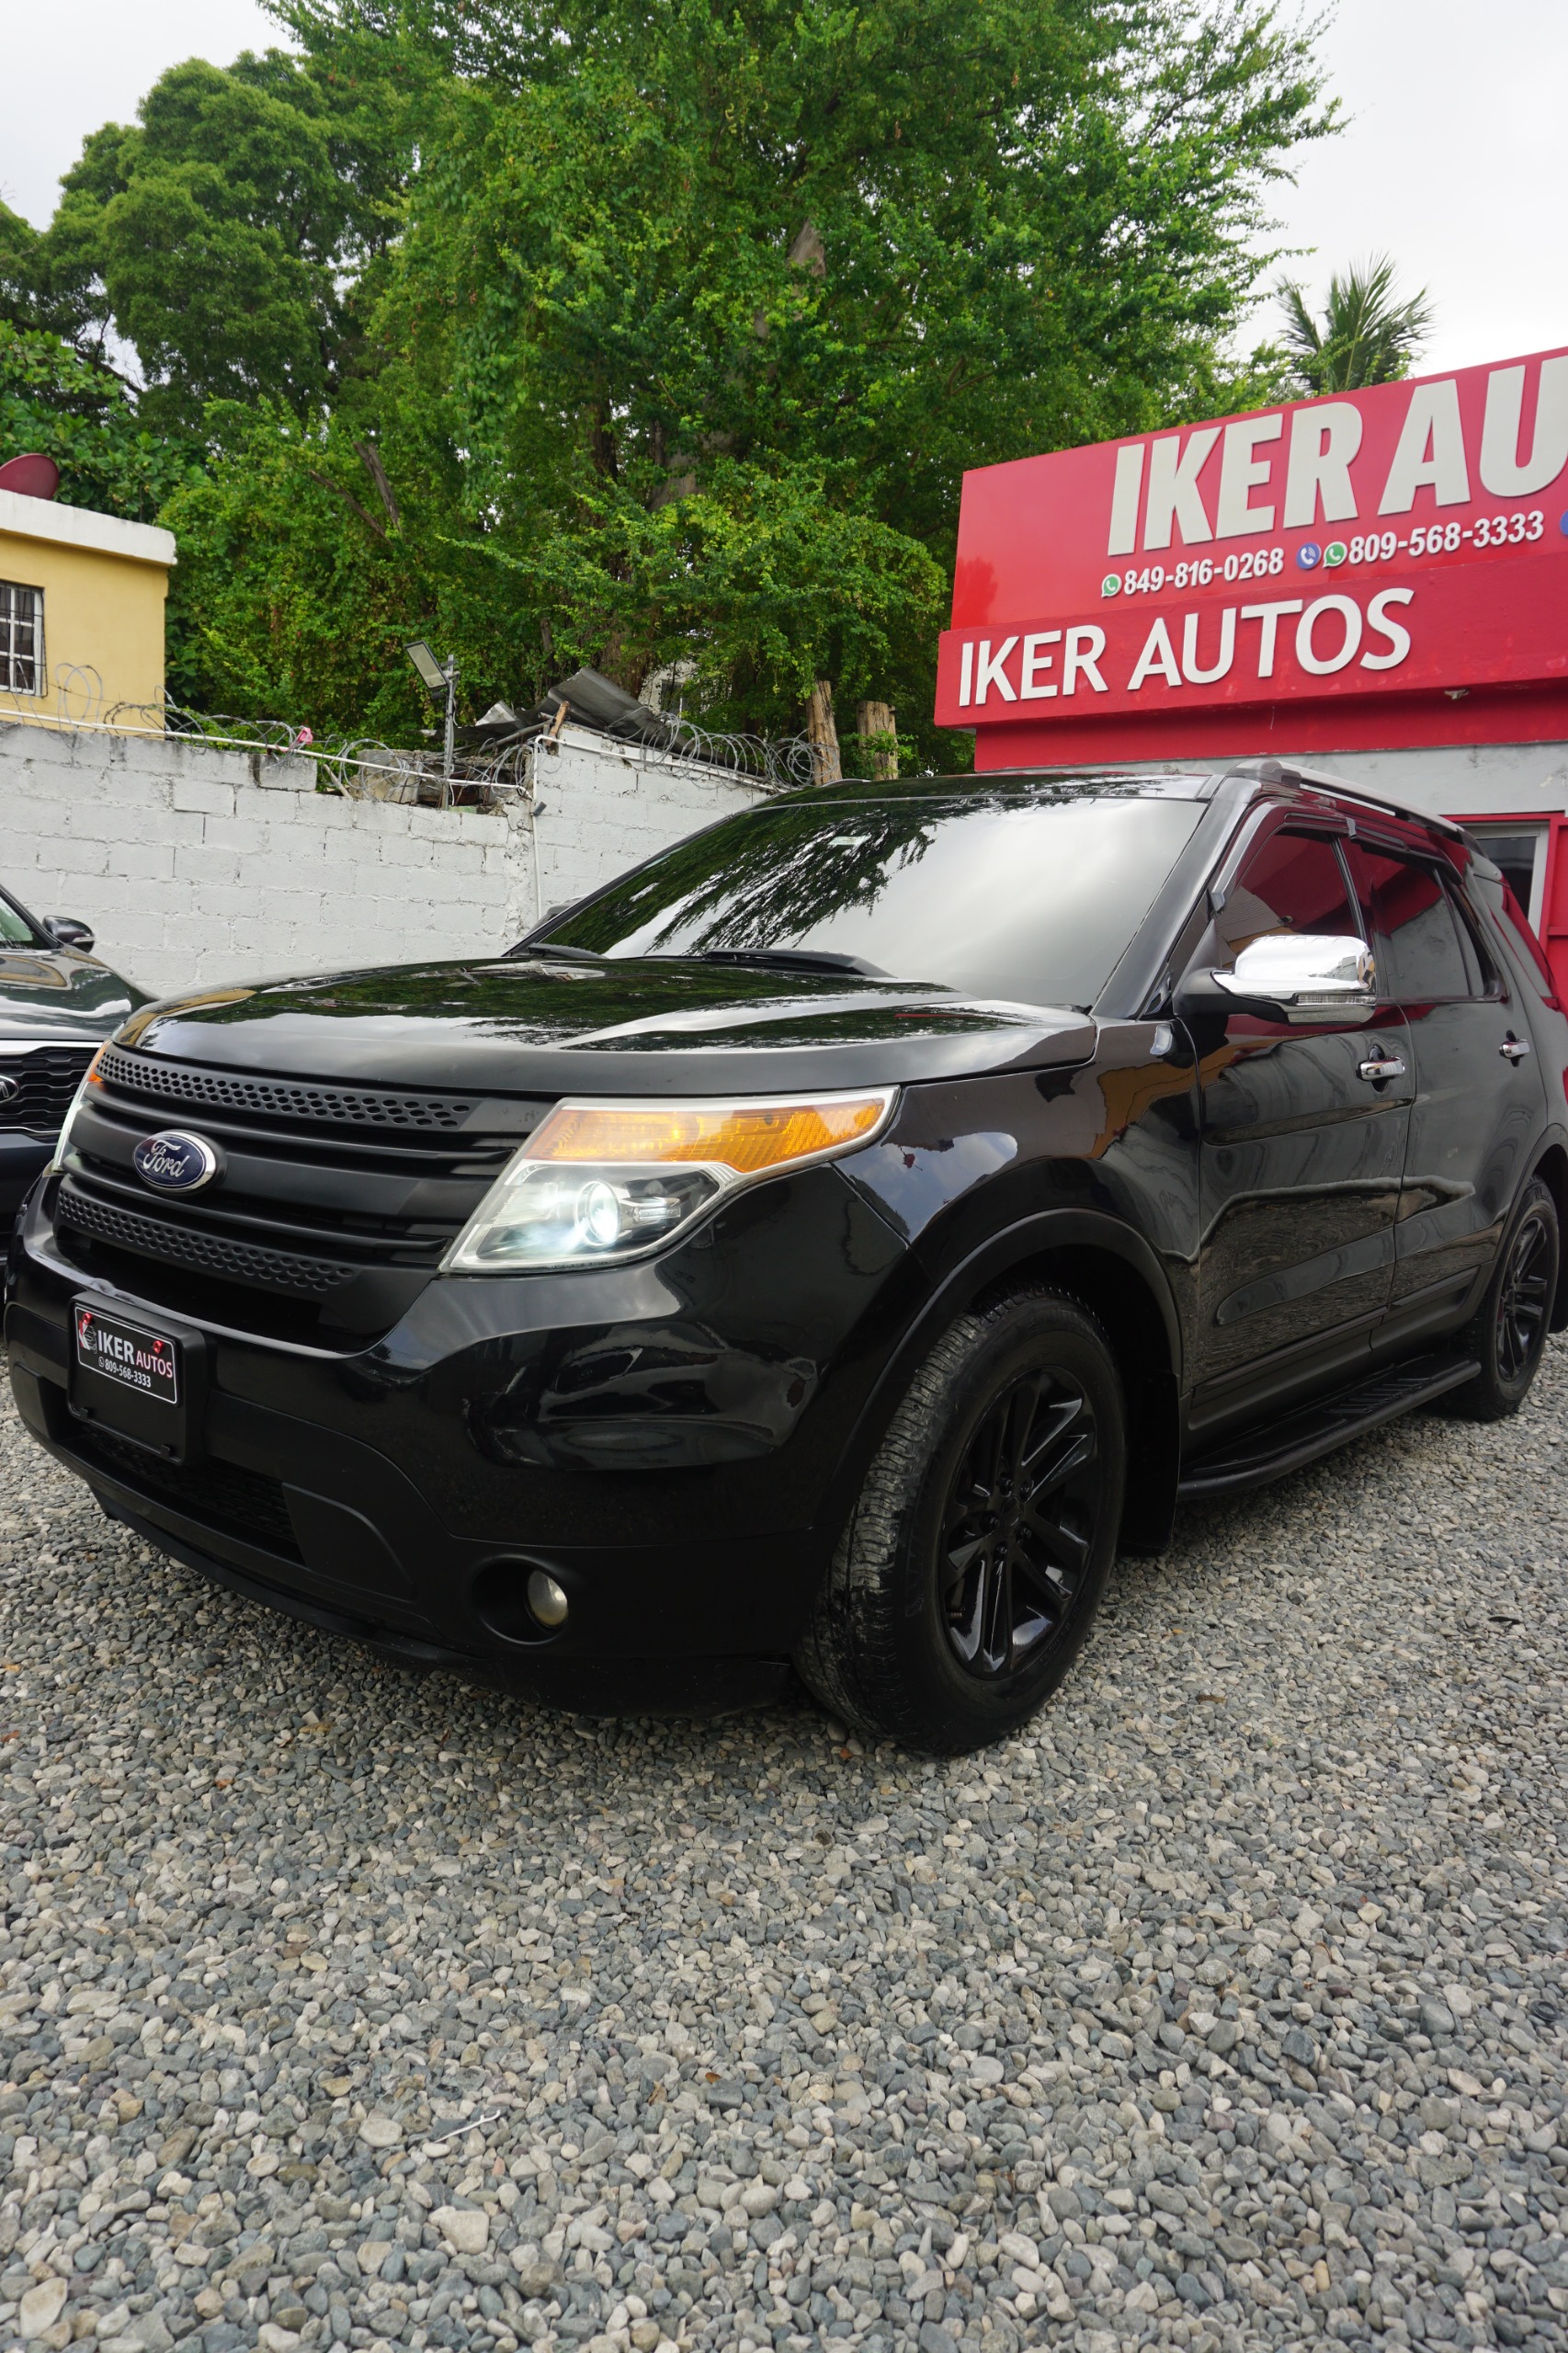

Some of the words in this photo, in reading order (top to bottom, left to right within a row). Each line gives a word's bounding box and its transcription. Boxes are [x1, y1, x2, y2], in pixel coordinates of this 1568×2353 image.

[1108, 401, 1363, 557] IKER
[1378, 355, 1568, 516] AU
[1124, 548, 1284, 595] 849-816-0268
[1349, 510, 1544, 564] 809-568-3333
[959, 624, 1108, 707] IKER
[1129, 587, 1415, 690] AUTOS
[142, 1140, 190, 1177] Ford
[97, 1329, 135, 1366] IKER
[136, 1350, 173, 1379] AUTOS
[105, 1358, 152, 1388] 809-568-3333
